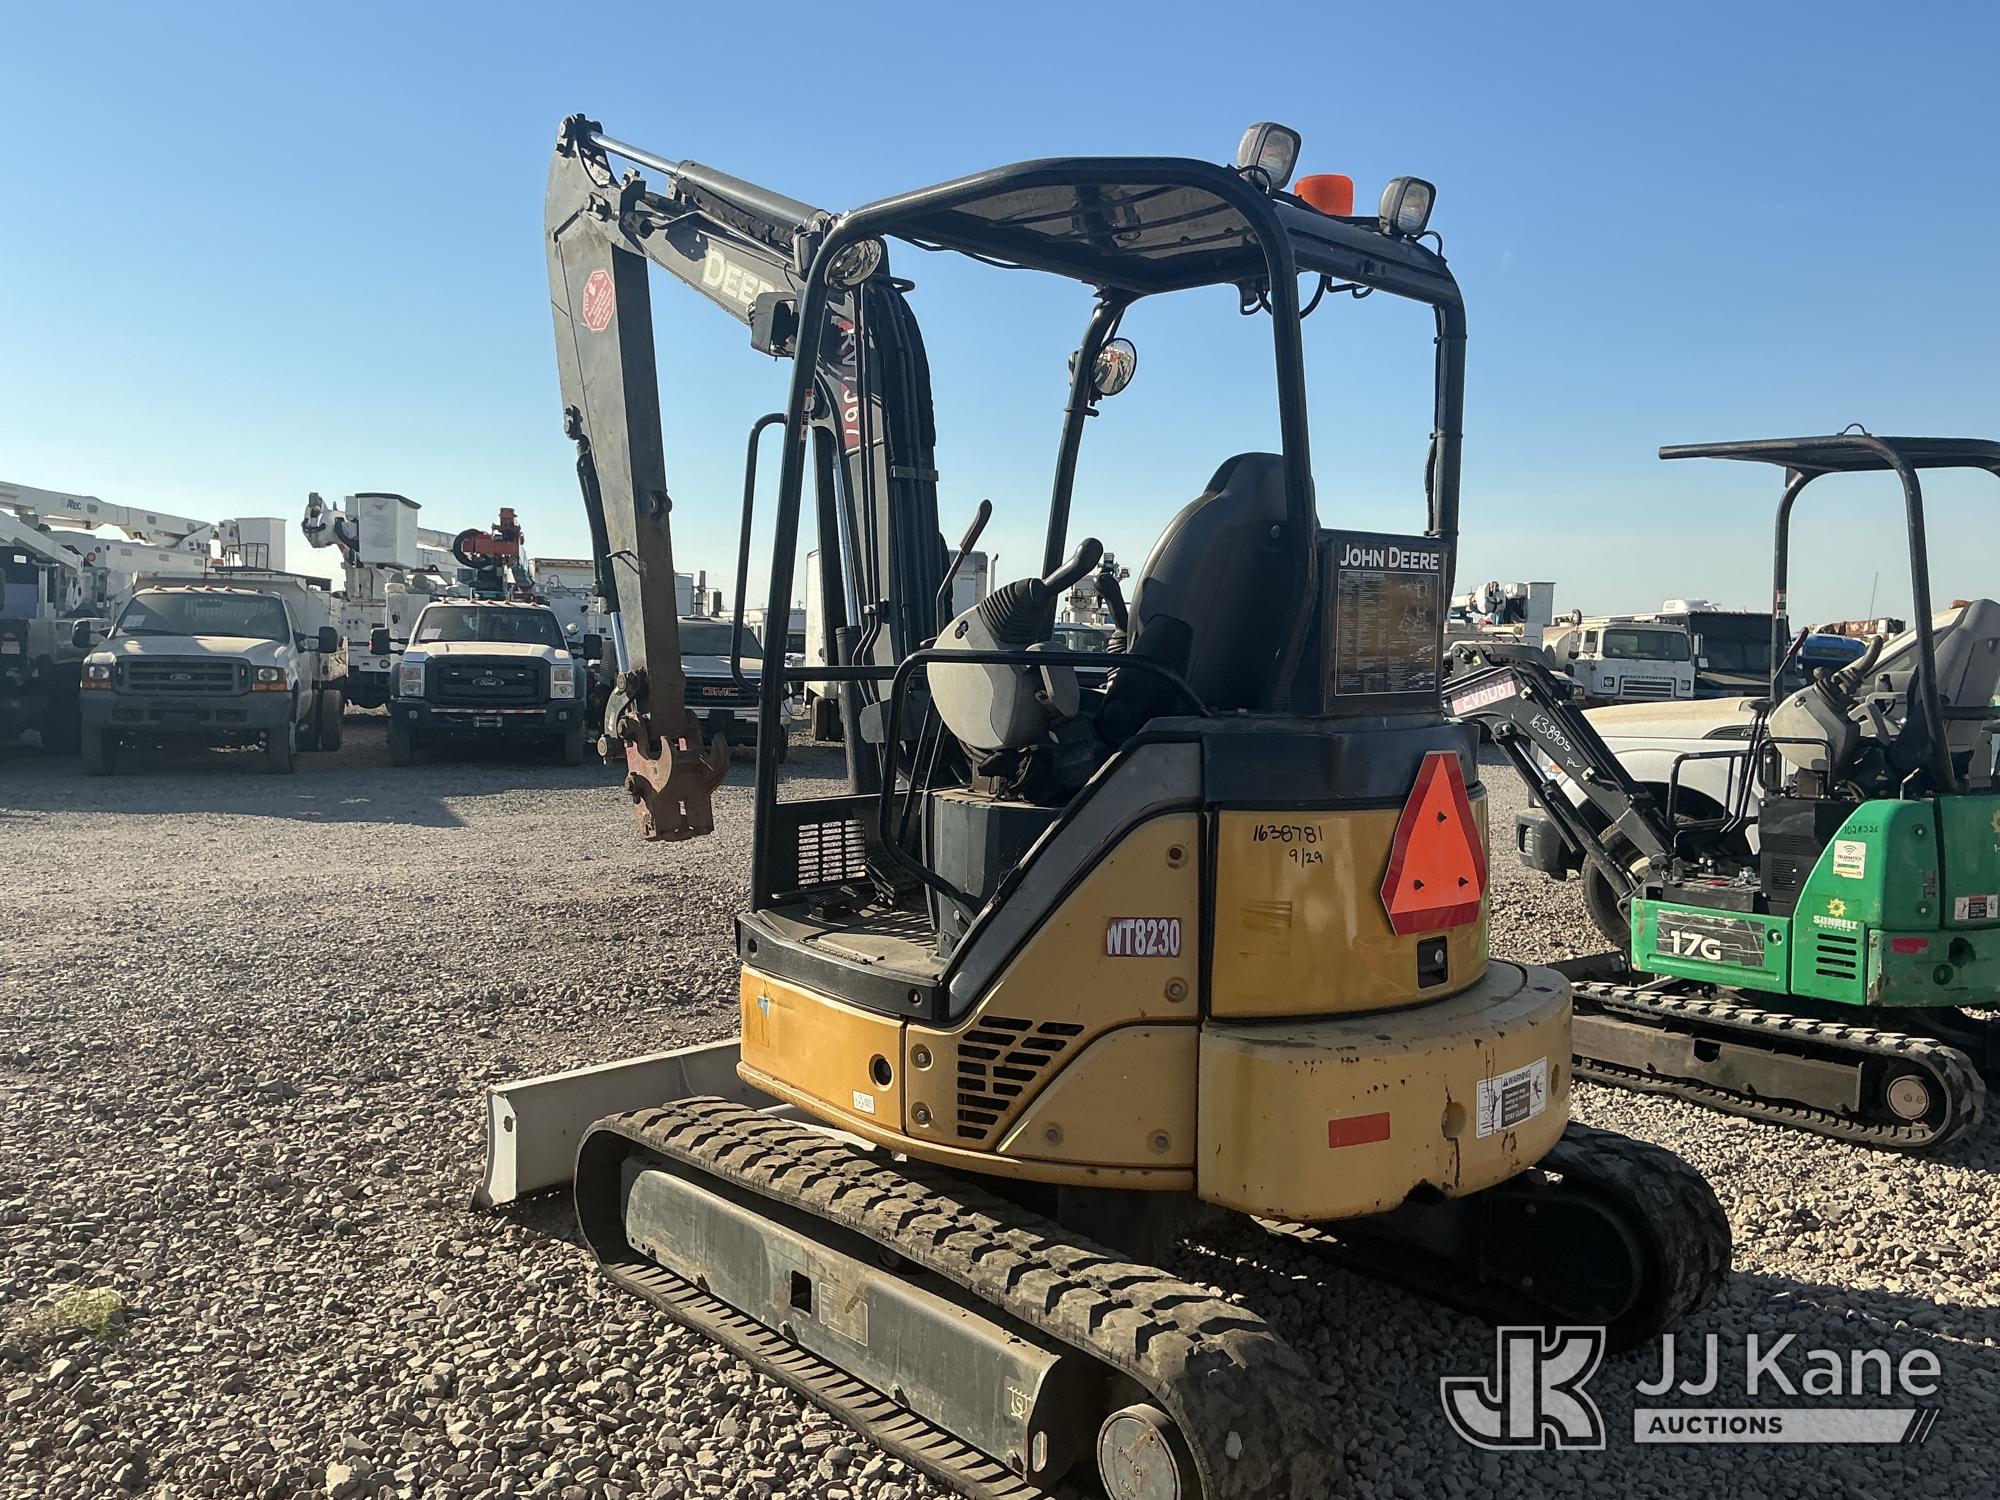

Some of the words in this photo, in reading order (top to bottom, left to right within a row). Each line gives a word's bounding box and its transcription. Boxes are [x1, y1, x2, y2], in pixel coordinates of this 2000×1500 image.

[1340, 544, 1385, 568] JOHN
[1388, 546, 1439, 570] DEERE
[703, 687, 739, 697] GMC
[1530, 712, 1571, 752] 1638905
[1253, 824, 1323, 843] 1638781
[1813, 915, 1858, 930] SUNBELT
[1106, 918, 1180, 956] WT8230
[1670, 930, 1722, 960] 17G
